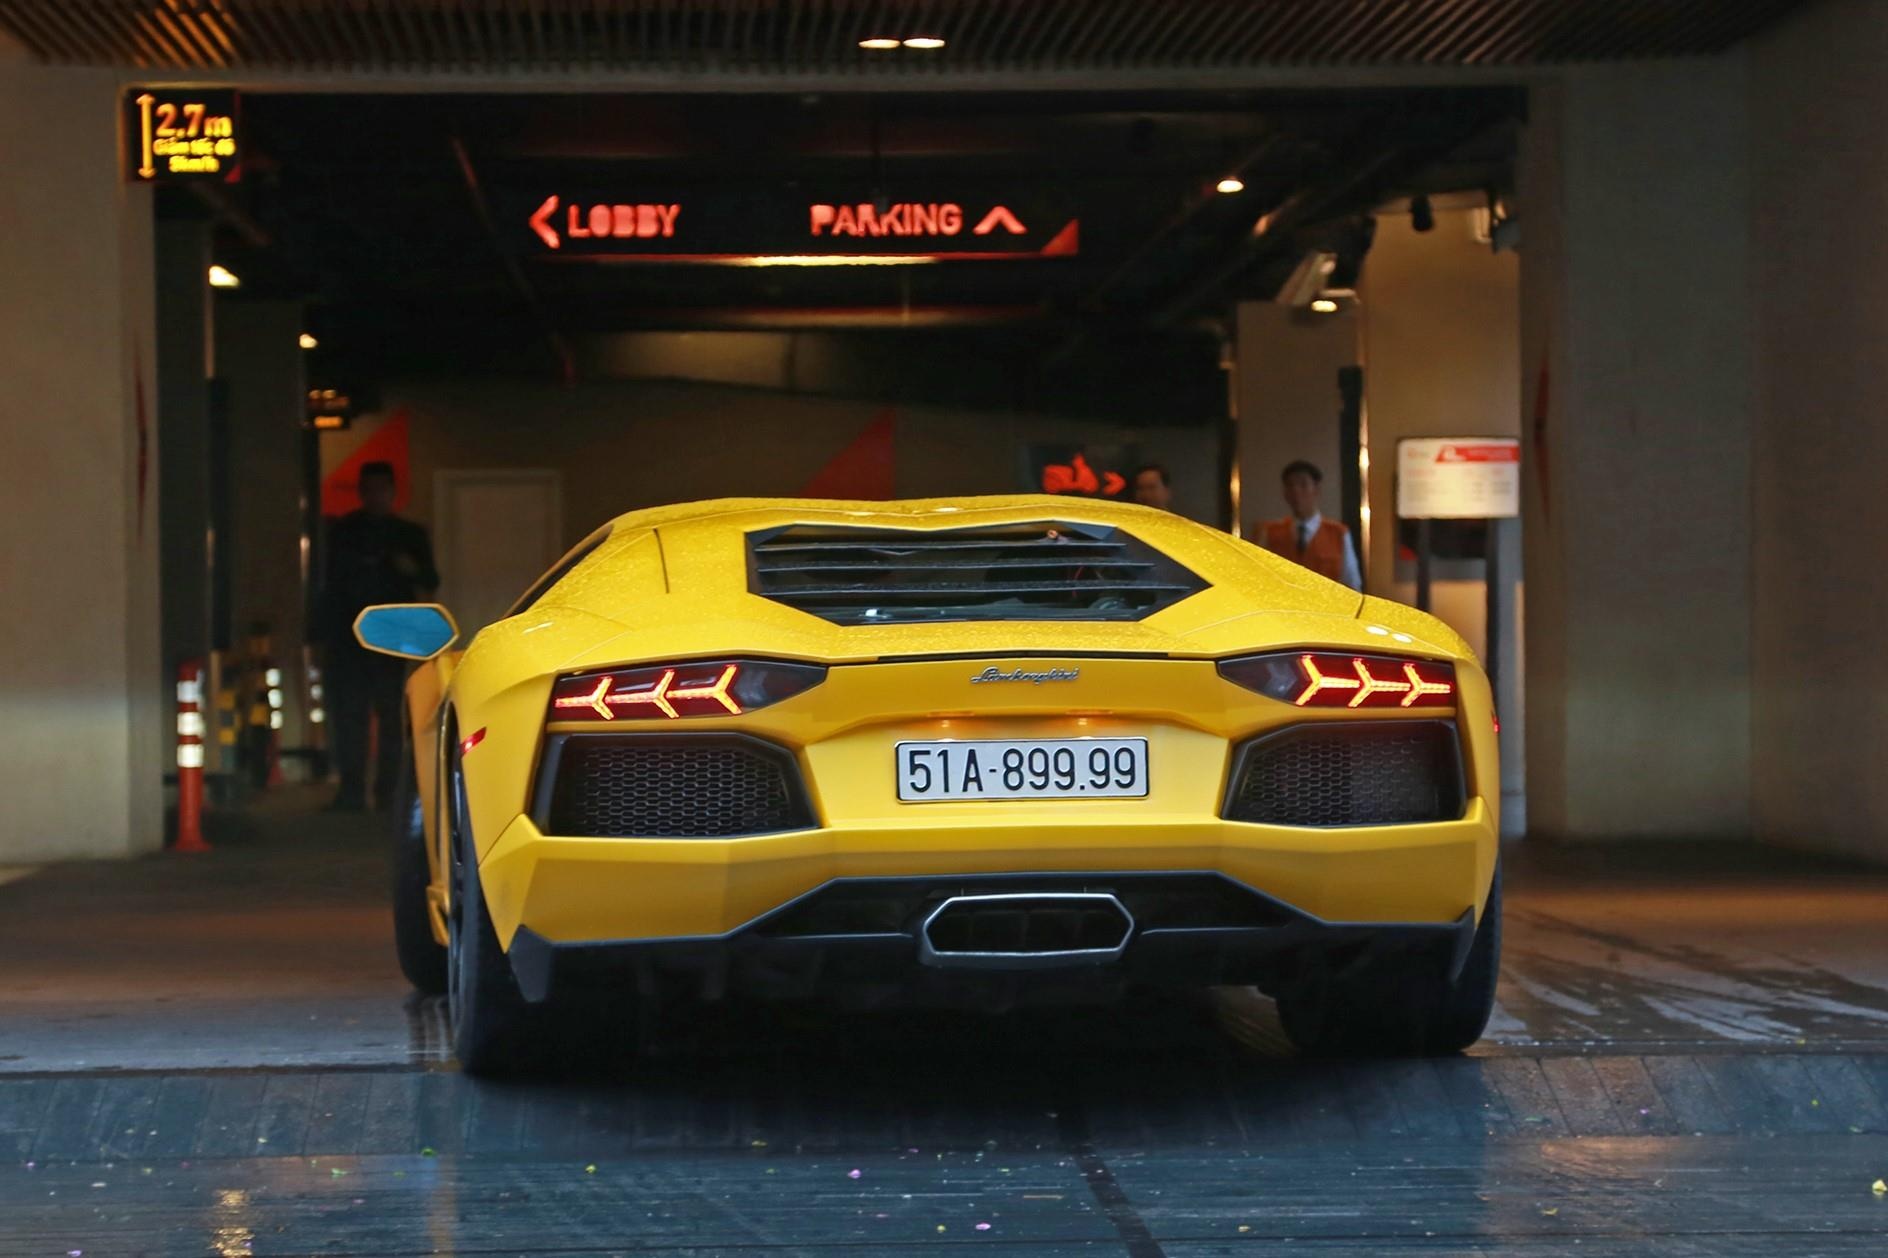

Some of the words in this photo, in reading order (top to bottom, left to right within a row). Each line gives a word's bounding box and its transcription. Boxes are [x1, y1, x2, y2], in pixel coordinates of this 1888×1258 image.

[567, 204, 681, 237] LOBBY
[809, 203, 962, 236] PARKING
[970, 666, 1080, 684] Lamborghini
[909, 747, 1136, 793] 51A-899.99
